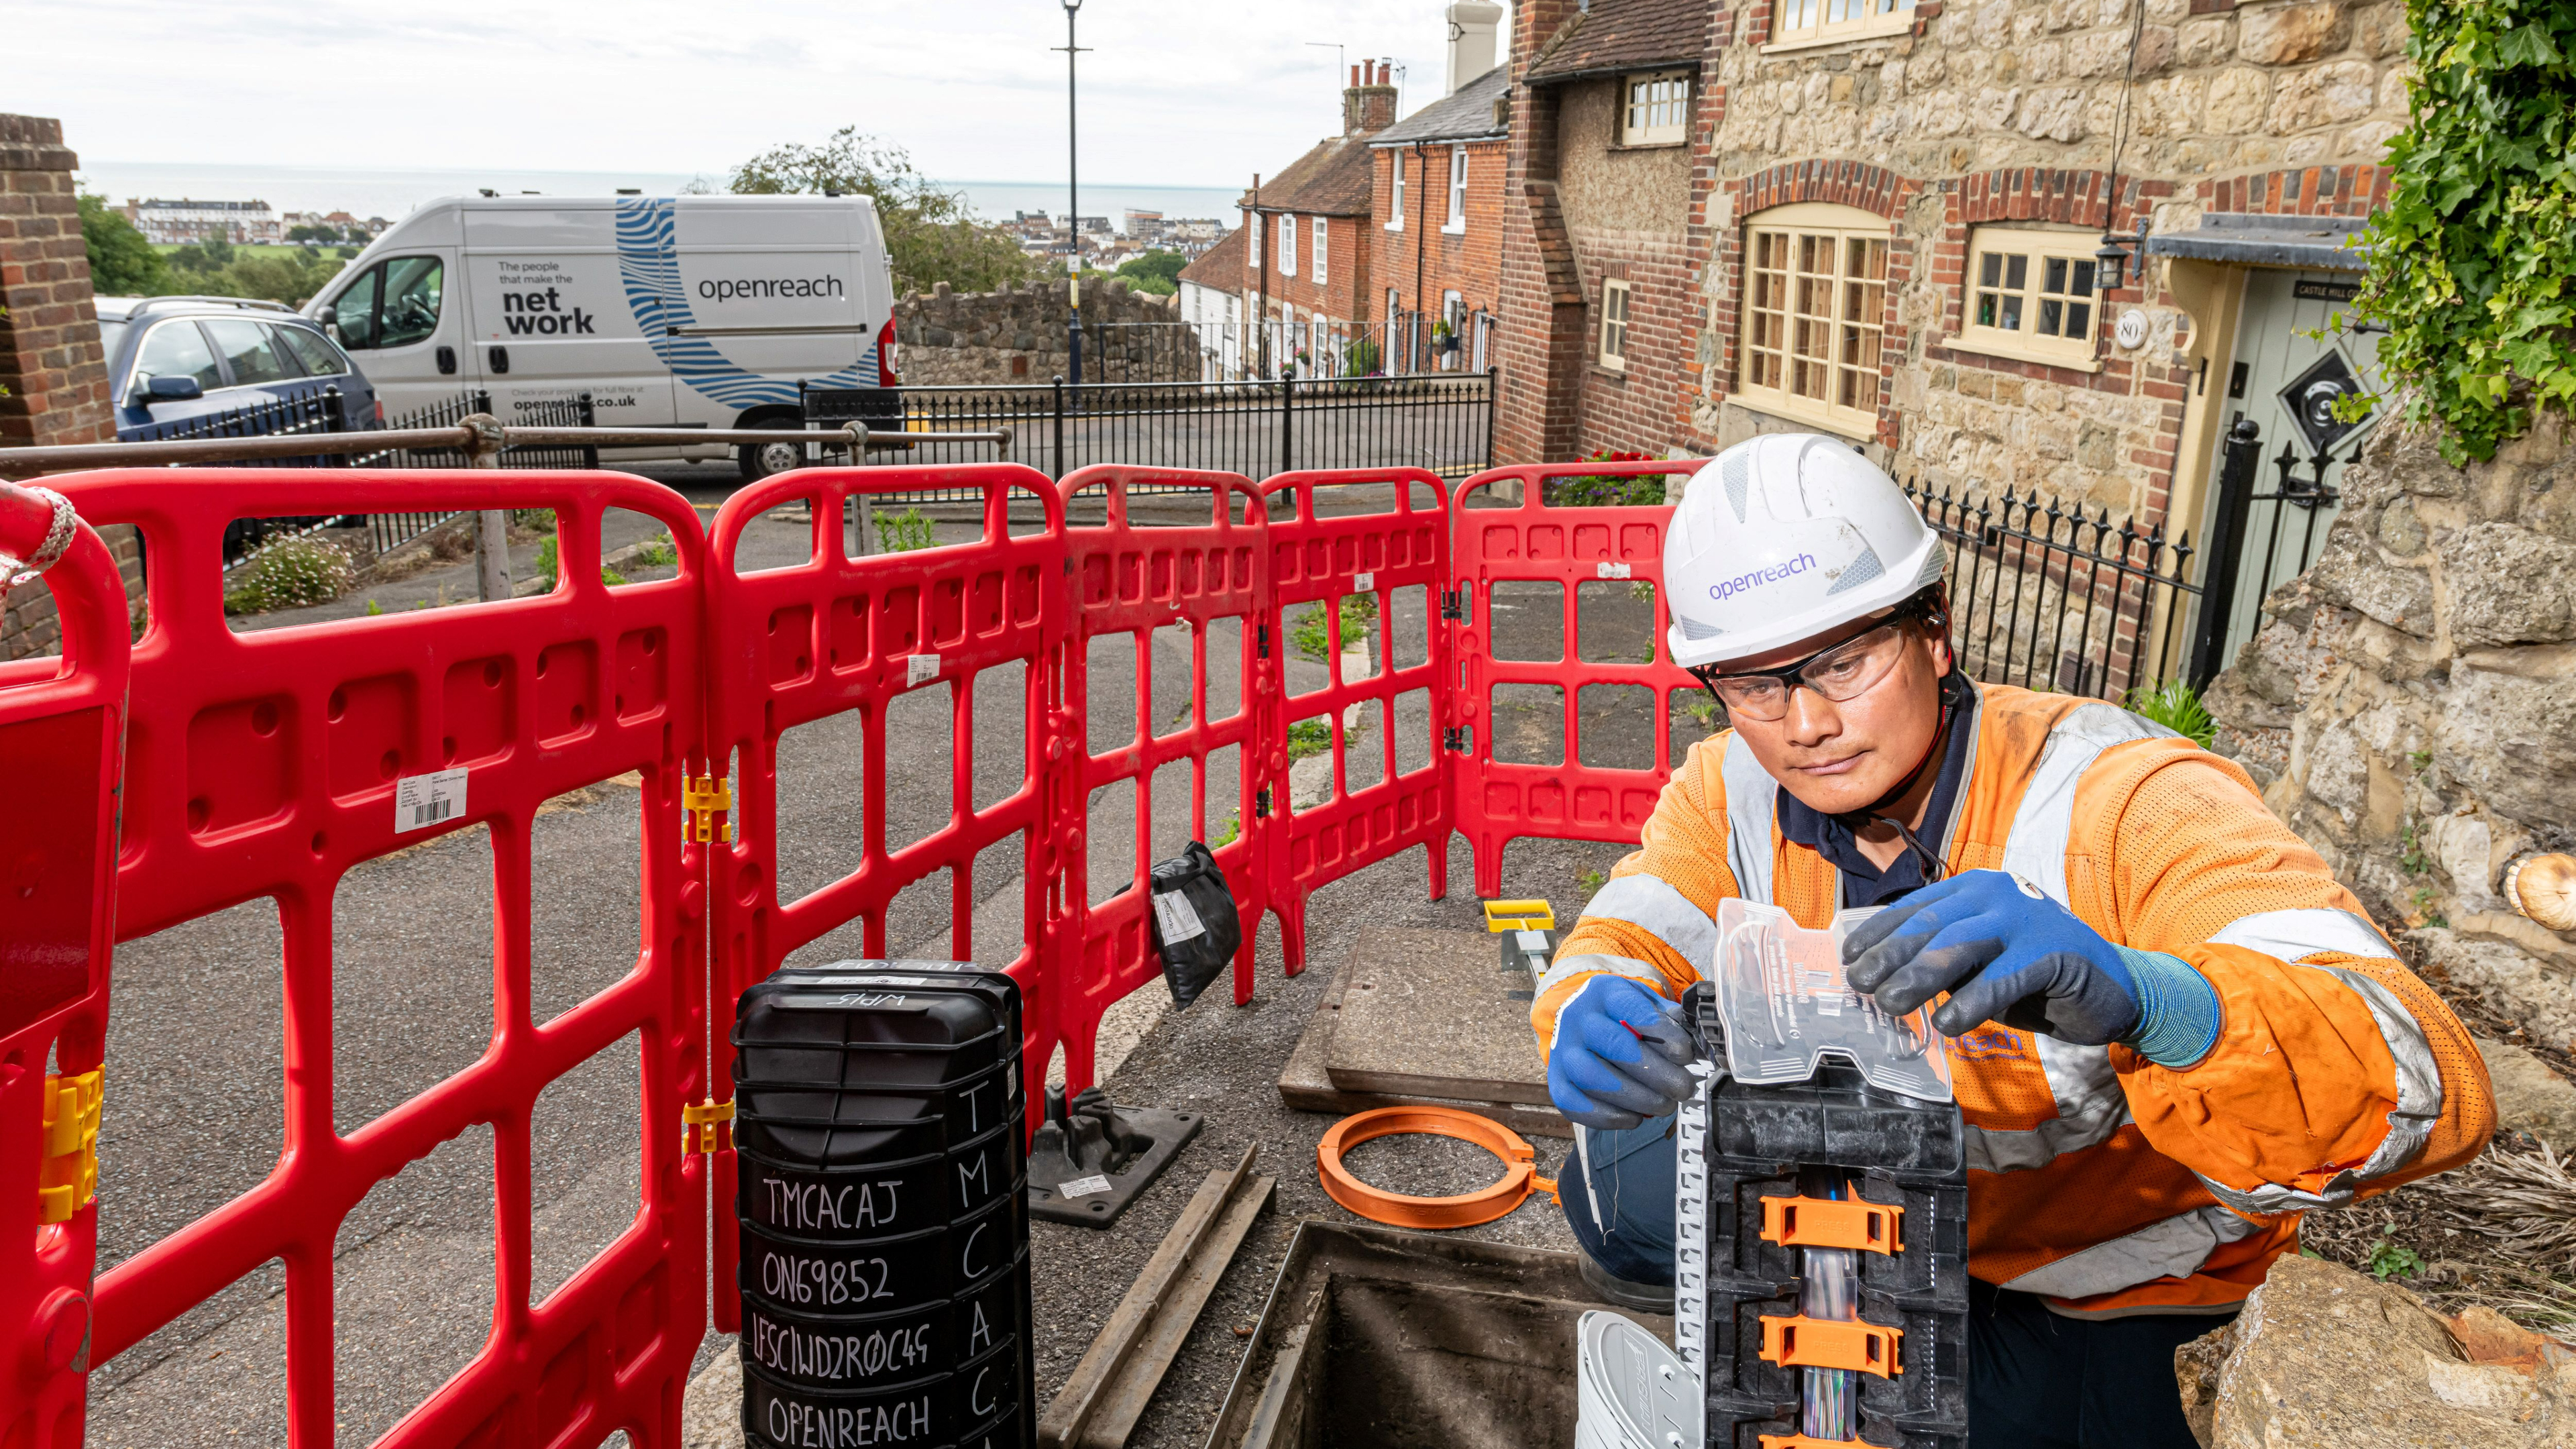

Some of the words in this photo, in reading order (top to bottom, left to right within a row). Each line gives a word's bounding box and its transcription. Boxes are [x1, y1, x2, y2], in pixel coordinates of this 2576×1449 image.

[498, 261, 519, 271] The
[522, 261, 559, 272] people
[499, 274, 521, 284] that
[524, 274, 553, 284] make
[555, 274, 573, 284] the
[699, 274, 843, 303] openreach
[503, 287, 561, 312] net
[2299, 285, 2327, 296] CASTLE
[2328, 288, 2345, 298] HILL
[504, 307, 596, 335] work
[2121, 320, 2139, 339] 80
[618, 386, 635, 394] fibre
[1709, 553, 1817, 600] openreach
[1792, 962, 1810, 1004] WARNING
[763, 1178, 903, 1229] TMCACAJ
[1815, 1220, 1851, 1232] PRESS
[1813, 1342, 1850, 1353] PRESS
[769, 1395, 930, 1449] OPENREACH
